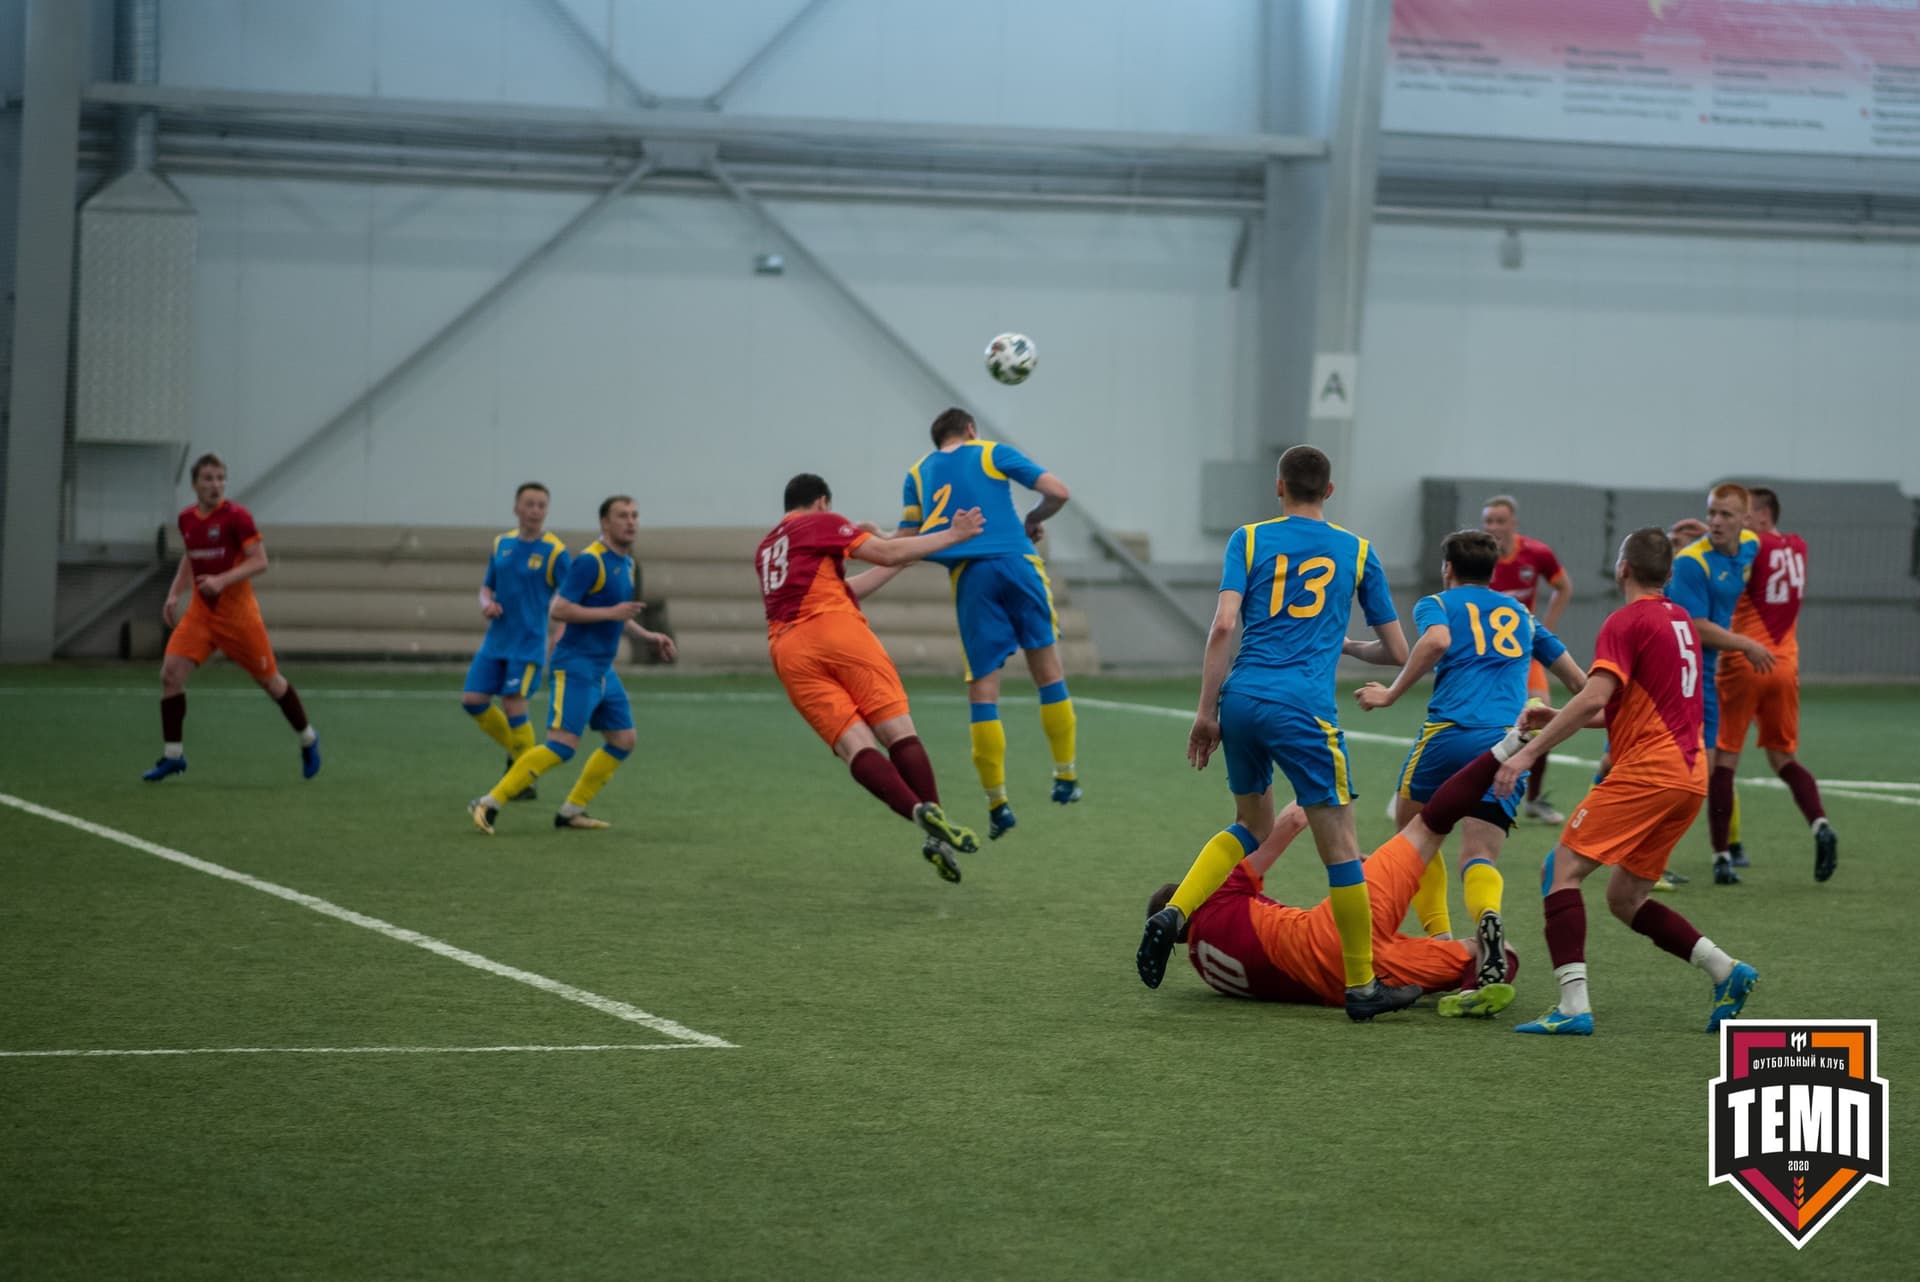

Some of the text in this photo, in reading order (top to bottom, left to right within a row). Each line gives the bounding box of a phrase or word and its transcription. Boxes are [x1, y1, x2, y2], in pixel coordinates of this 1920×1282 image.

[1320, 371, 1347, 402] A
[919, 483, 952, 533] 2
[761, 534, 790, 596] 13
[1270, 554, 1336, 618] 13
[1765, 546, 1805, 603] 24
[1465, 602, 1523, 658] 18
[1671, 620, 1699, 698] 5
